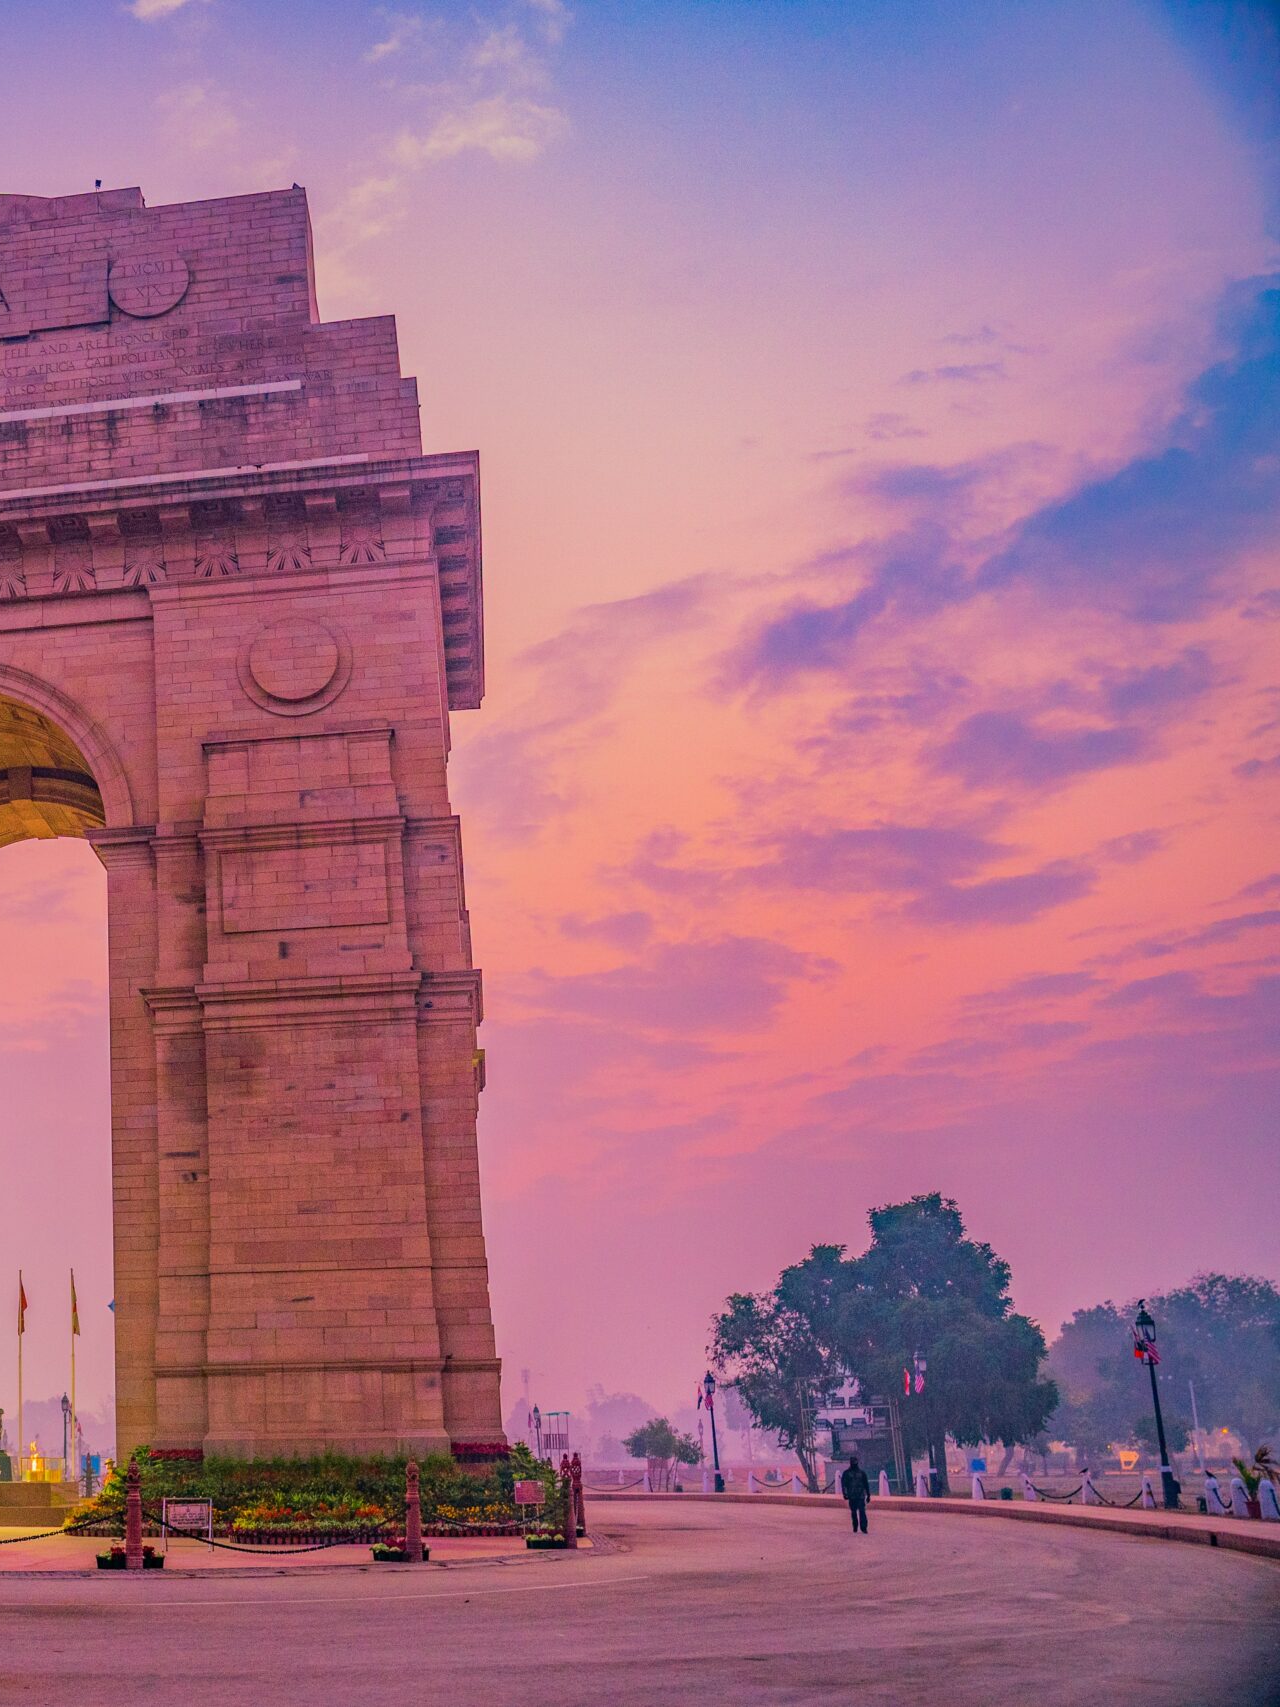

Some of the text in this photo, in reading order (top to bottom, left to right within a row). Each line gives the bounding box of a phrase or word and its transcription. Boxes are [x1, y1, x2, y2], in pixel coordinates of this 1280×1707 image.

[131, 261, 165, 277] MCM
[135, 283, 163, 298] XIX
[4, 346, 30, 361] FELL
[40, 341, 69, 356] AND
[77, 338, 103, 352] ARE
[114, 328, 189, 347] HONOURED
[29, 360, 75, 377] AFRICA
[85, 350, 147, 369] GALLIPOLI
[156, 346, 186, 360] AND
[197, 337, 275, 356] ELSEWHERE
[6, 383, 36, 398] ALSO
[44, 380, 59, 393] OF
[71, 375, 111, 390] THOSE
[122, 368, 166, 384] WHOSE
[180, 361, 224, 377] NAMES
[237, 357, 263, 372] ARE
[301, 370, 331, 383] WAR
